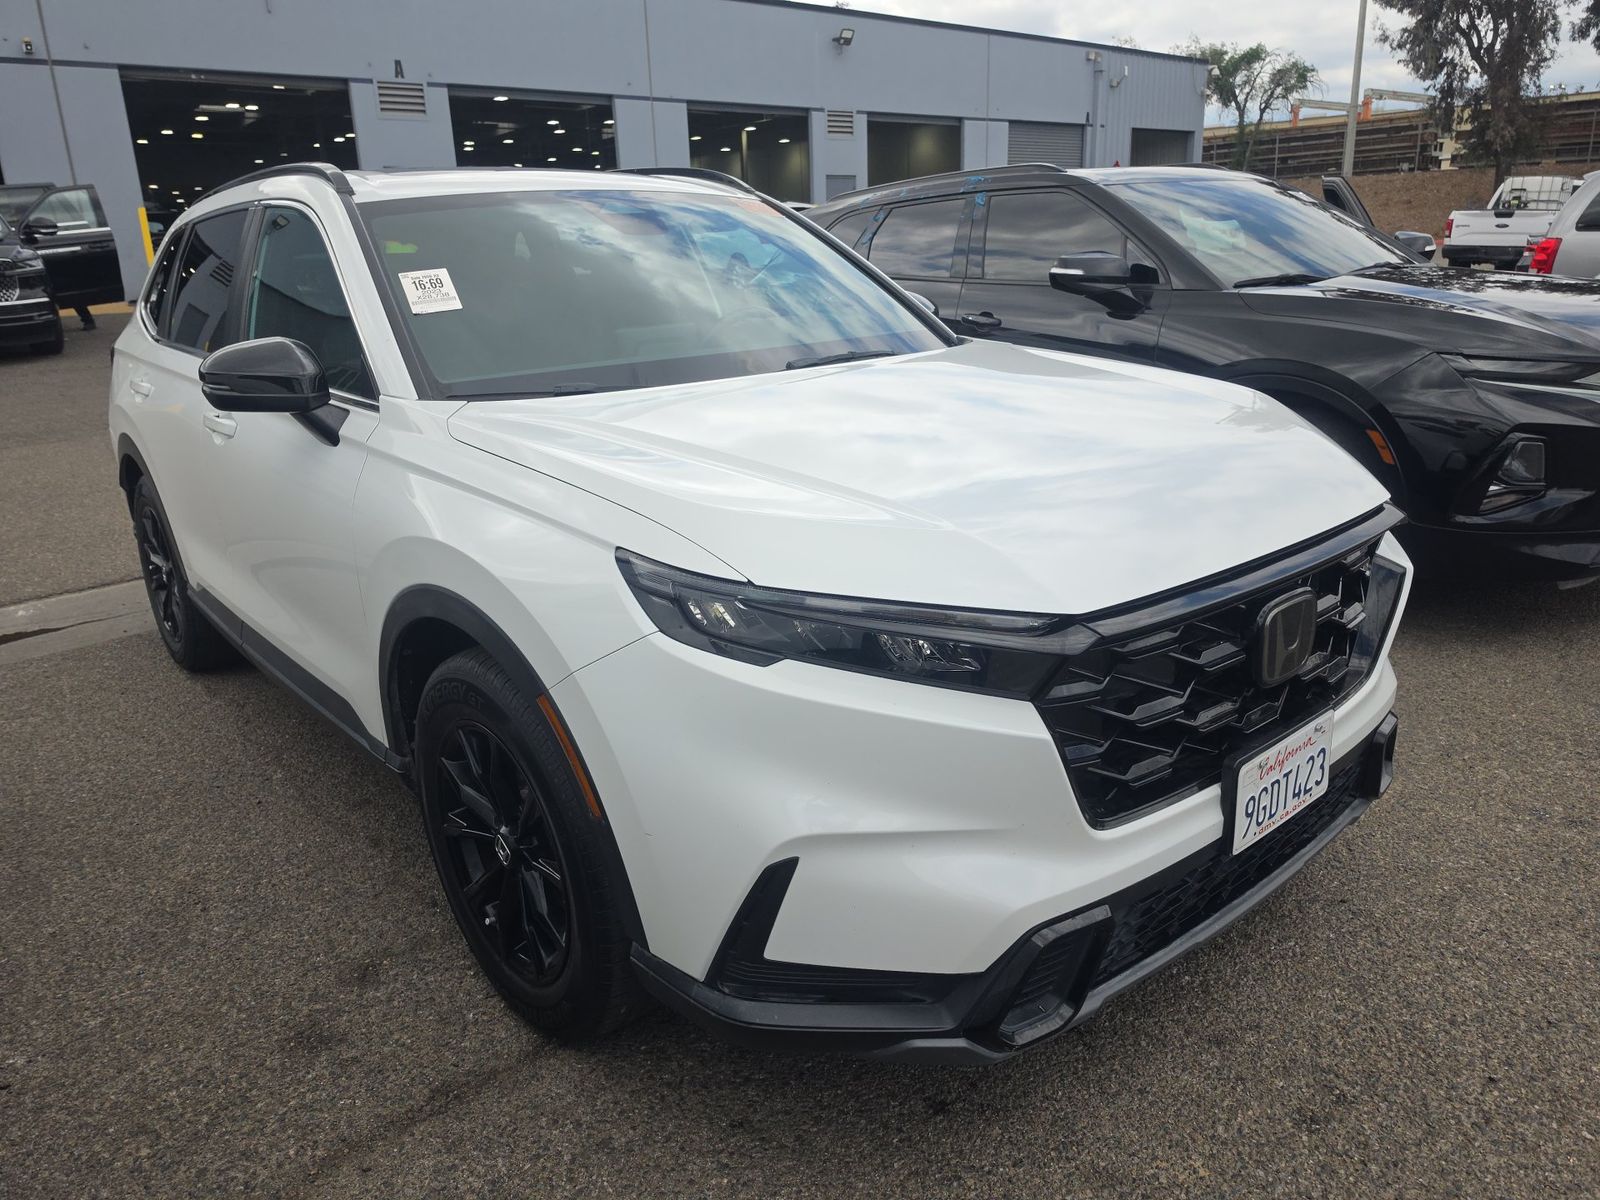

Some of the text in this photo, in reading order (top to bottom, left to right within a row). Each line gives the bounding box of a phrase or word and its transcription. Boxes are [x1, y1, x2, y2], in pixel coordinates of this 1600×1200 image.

[394, 59, 405, 79] A
[412, 277, 444, 291] 16:69
[1259, 736, 1318, 780] California
[1242, 747, 1327, 840] 9GDT423
